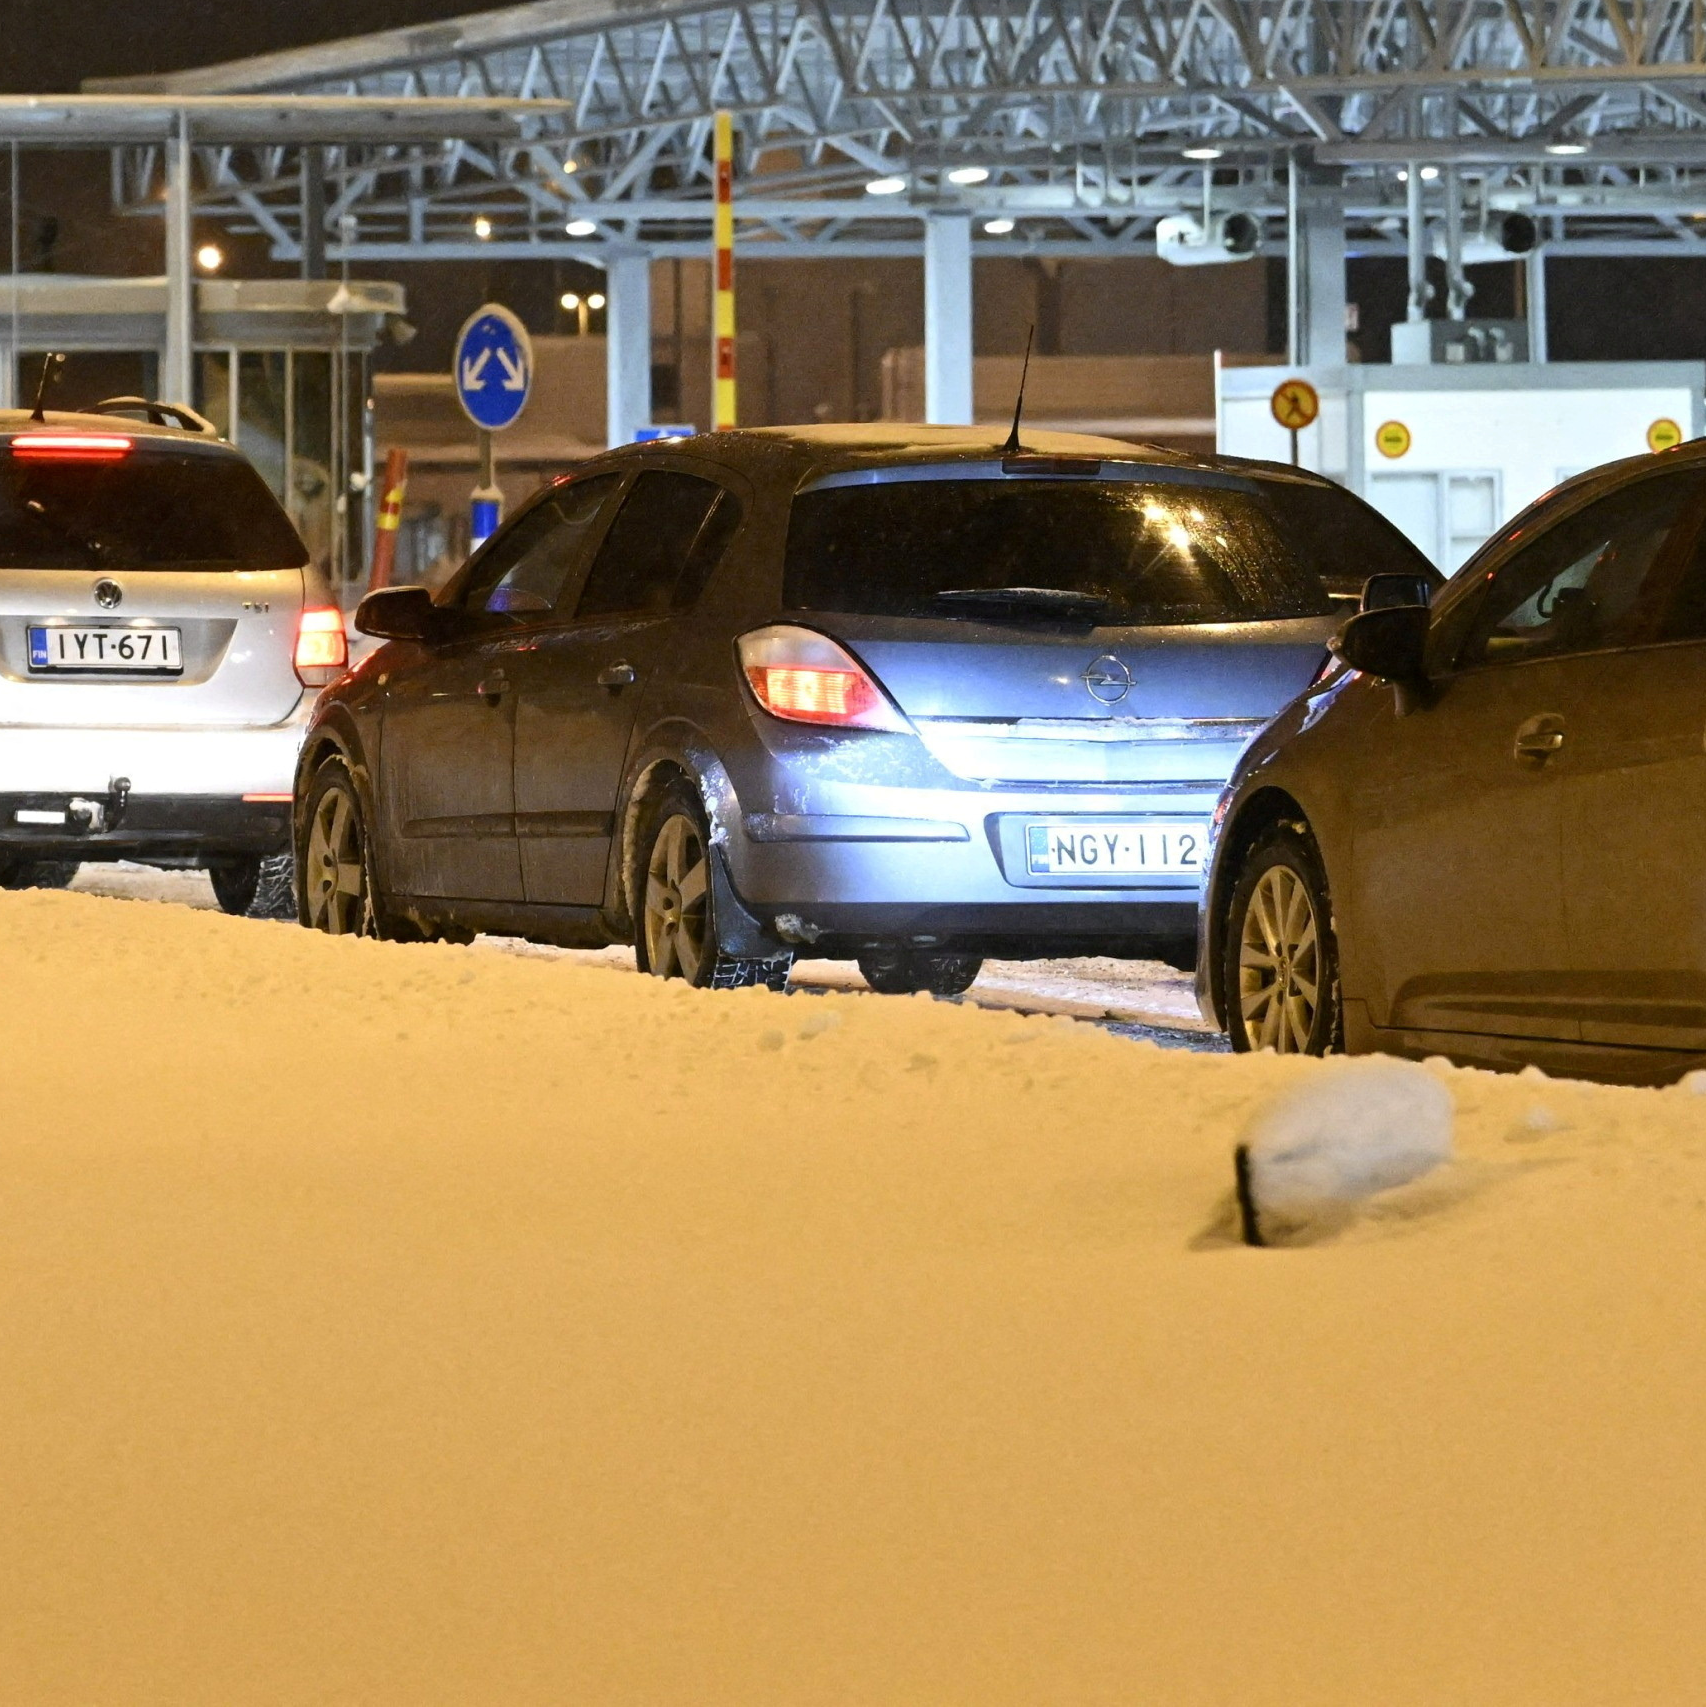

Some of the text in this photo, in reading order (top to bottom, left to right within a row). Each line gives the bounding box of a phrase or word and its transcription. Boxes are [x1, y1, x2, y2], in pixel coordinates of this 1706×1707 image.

[32, 633, 169, 661] FIN IYT-671
[1056, 834, 1198, 866] NGY-112
